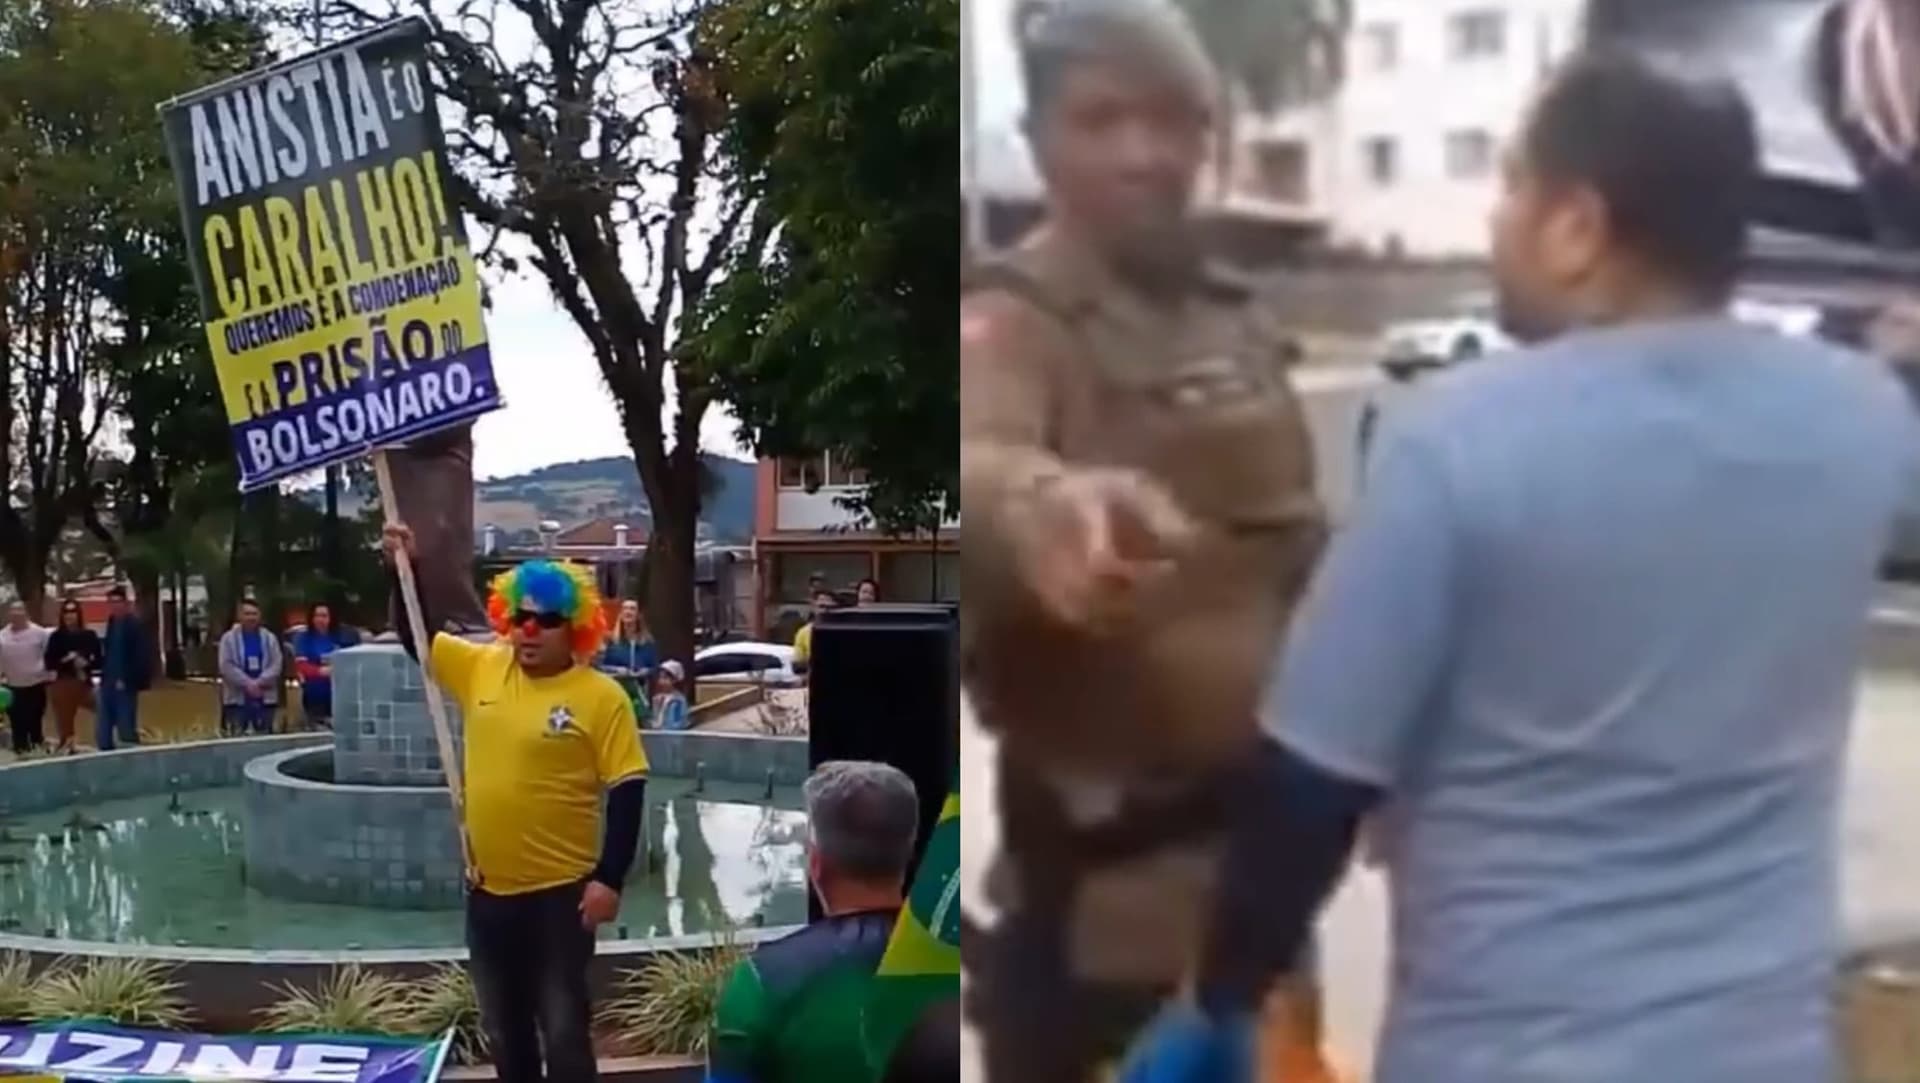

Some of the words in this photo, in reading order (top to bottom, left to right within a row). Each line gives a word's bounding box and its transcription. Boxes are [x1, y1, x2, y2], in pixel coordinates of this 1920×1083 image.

[189, 46, 389, 206] ANISTIA
[381, 57, 404, 121] É
[402, 61, 425, 113] O
[204, 151, 456, 319] CARALHO!
[224, 299, 315, 355] QUEREMOS
[332, 289, 346, 322] A
[259, 379, 274, 416] A
[272, 314, 434, 412] PRISÃO
[440, 318, 463, 357] DO
[246, 361, 484, 474] BOLSONARO.
